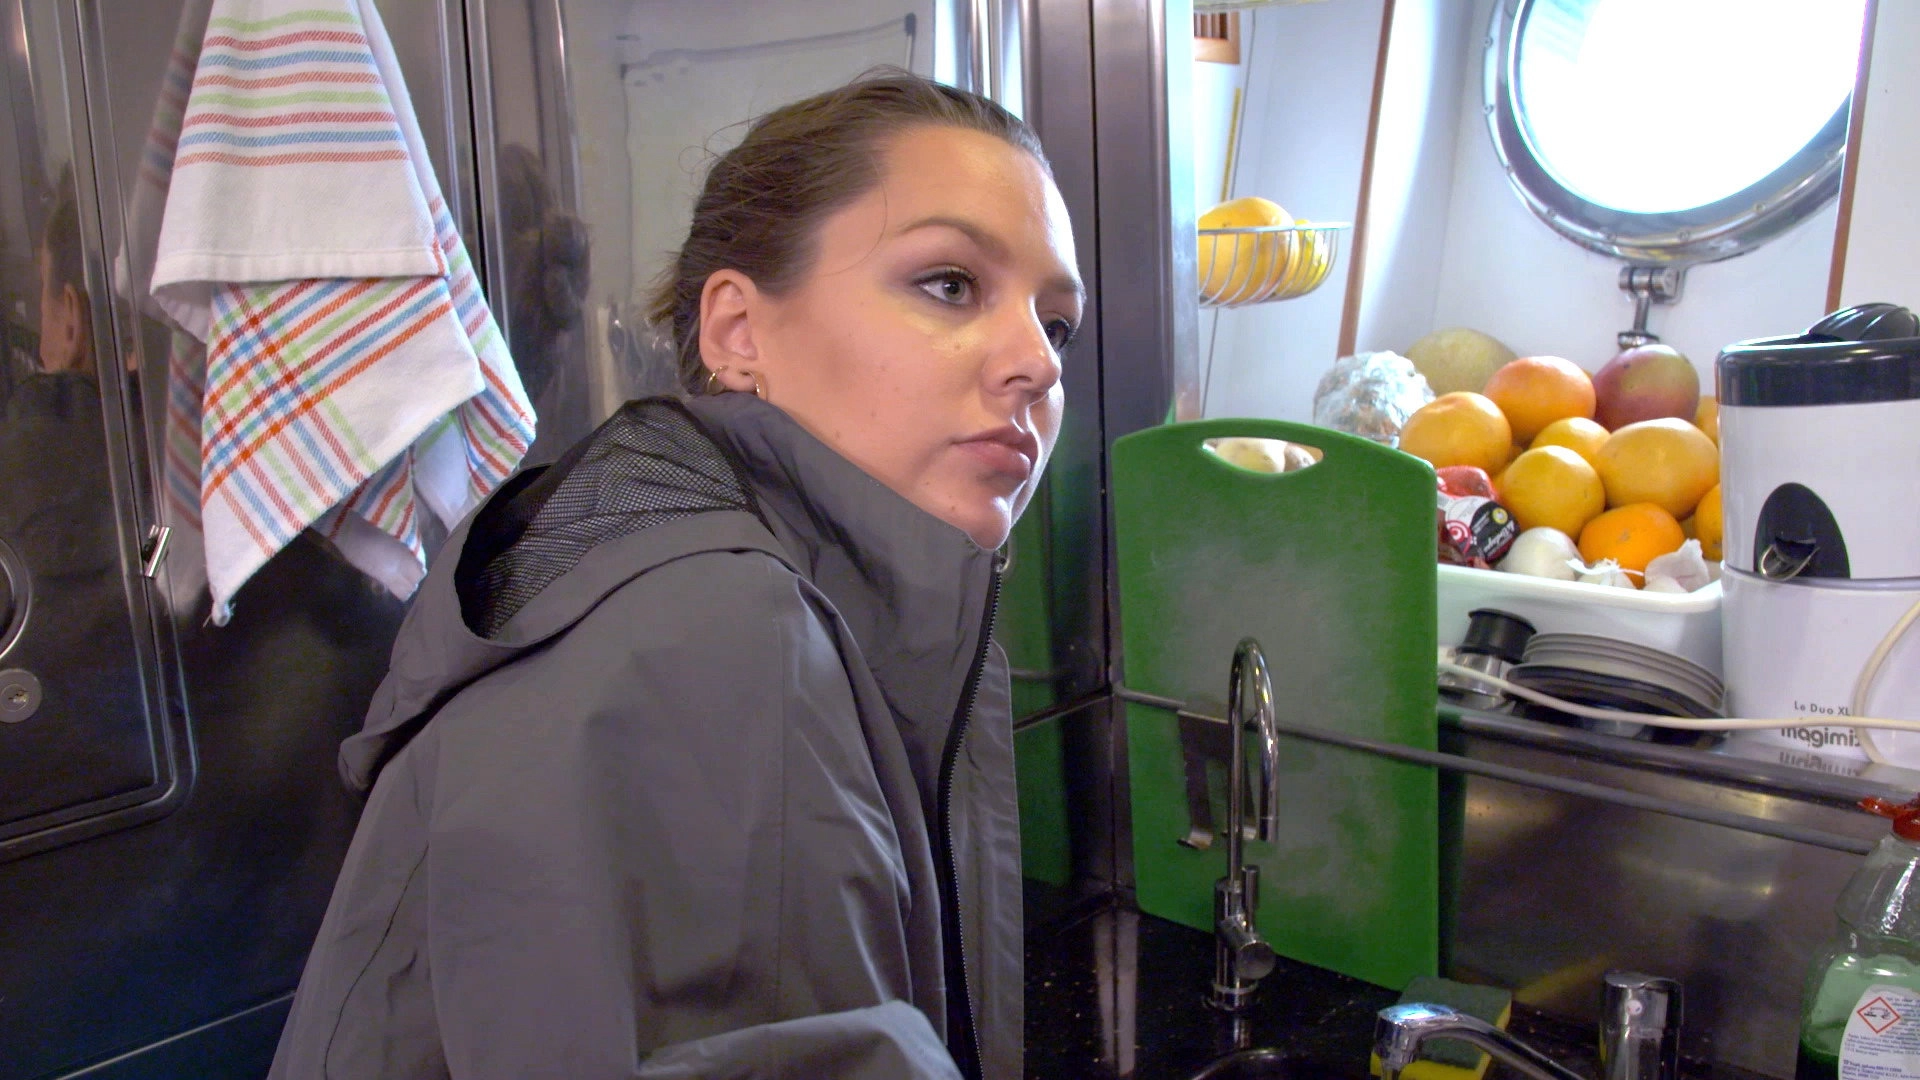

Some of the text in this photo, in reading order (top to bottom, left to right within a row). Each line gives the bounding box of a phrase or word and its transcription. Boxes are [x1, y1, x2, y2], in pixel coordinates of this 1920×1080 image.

[1794, 700, 1851, 717] Le Duo XL
